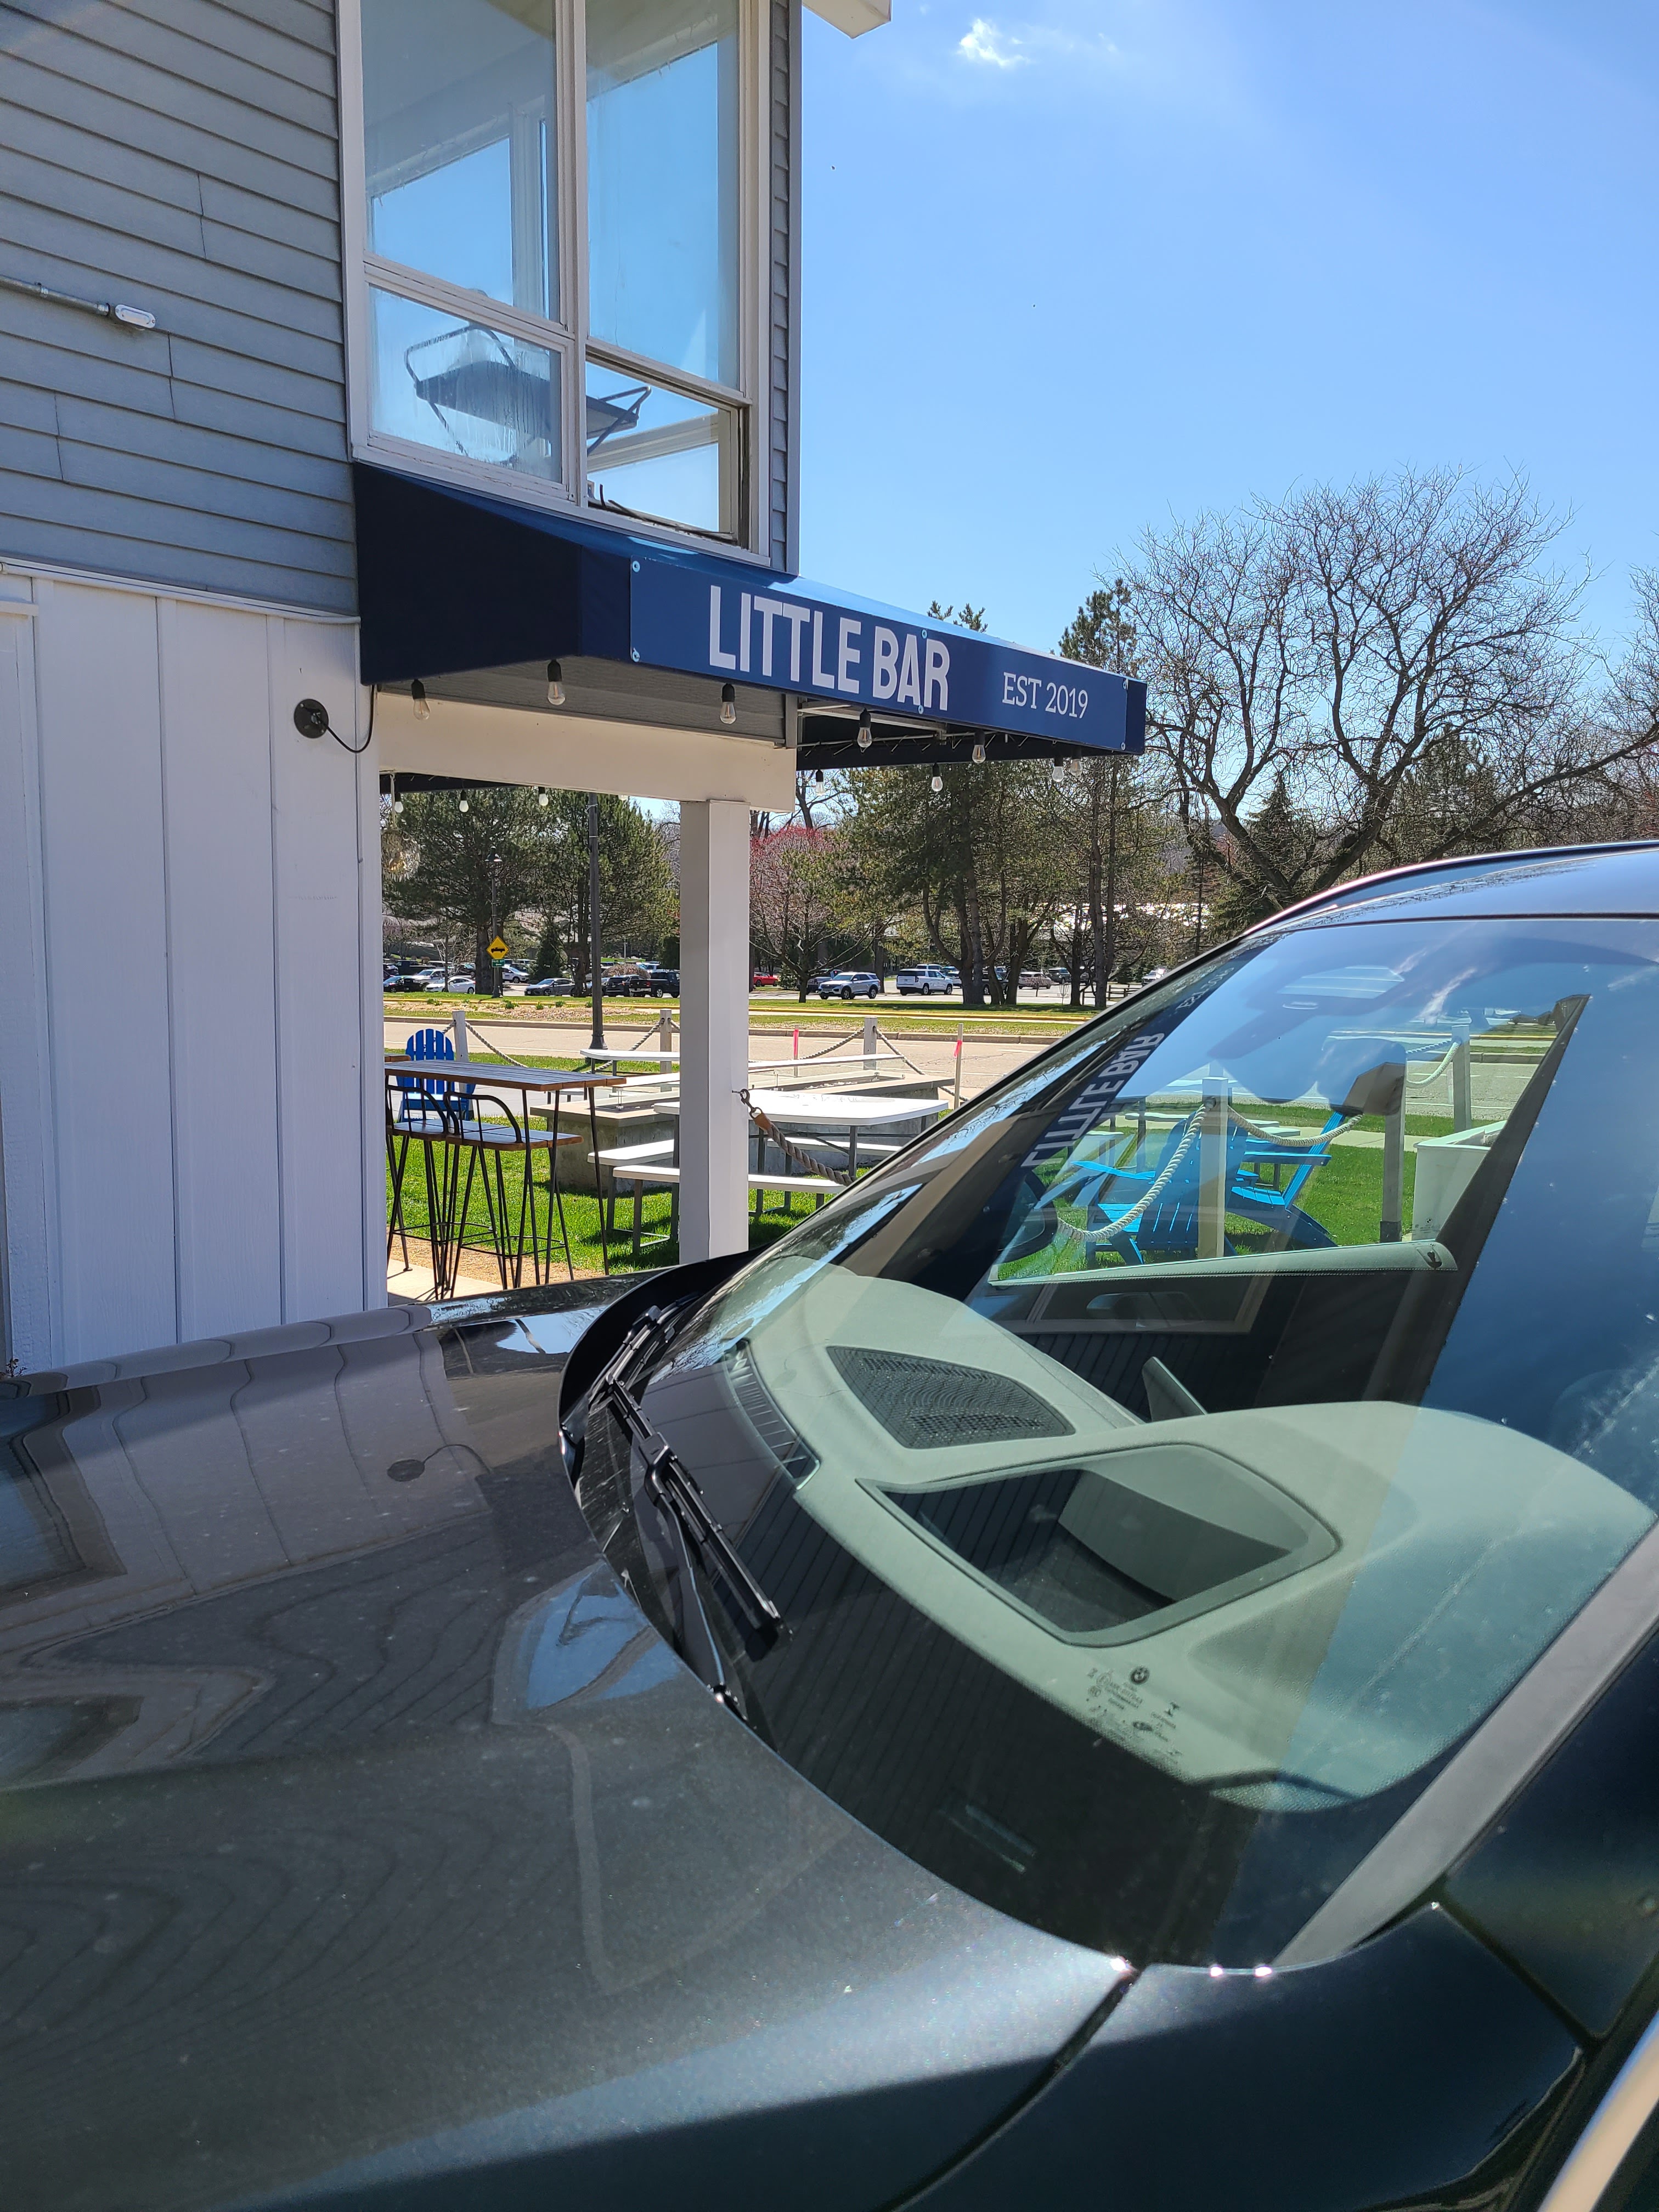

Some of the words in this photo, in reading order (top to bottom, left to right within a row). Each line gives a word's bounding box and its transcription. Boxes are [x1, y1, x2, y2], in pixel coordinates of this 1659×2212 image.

[709, 585, 861, 694] LITTLE
[872, 625, 950, 711] BAR
[1002, 672, 1042, 709] EST
[1045, 682, 1088, 718] 2019
